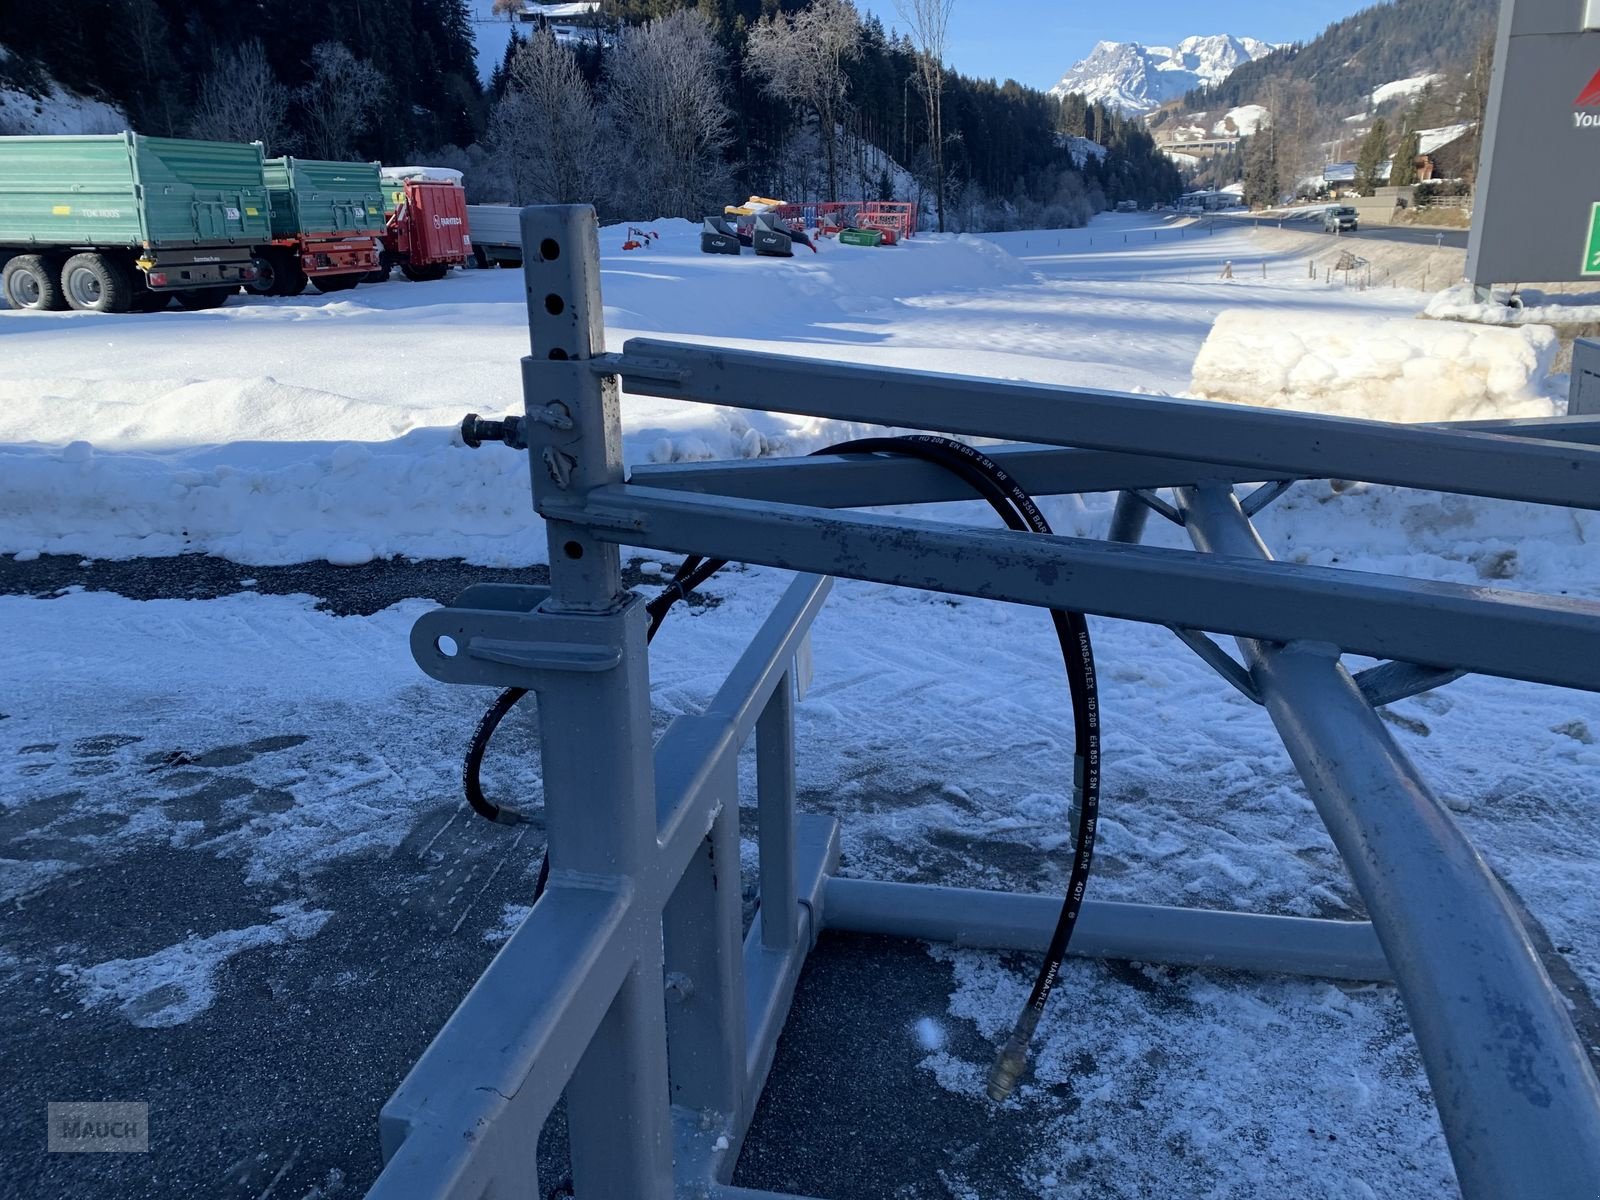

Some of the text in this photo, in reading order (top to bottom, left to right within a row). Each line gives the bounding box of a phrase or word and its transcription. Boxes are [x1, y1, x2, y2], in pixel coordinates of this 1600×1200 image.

[1574, 111, 1600, 127] You
[948, 441, 961, 450] EN
[982, 459, 995, 470] SN
[1013, 487, 1025, 499] WP
[1023, 500, 1035, 515] 350
[1033, 515, 1047, 533] BAR
[1089, 777, 1098, 790] SN
[1085, 819, 1095, 833] WP
